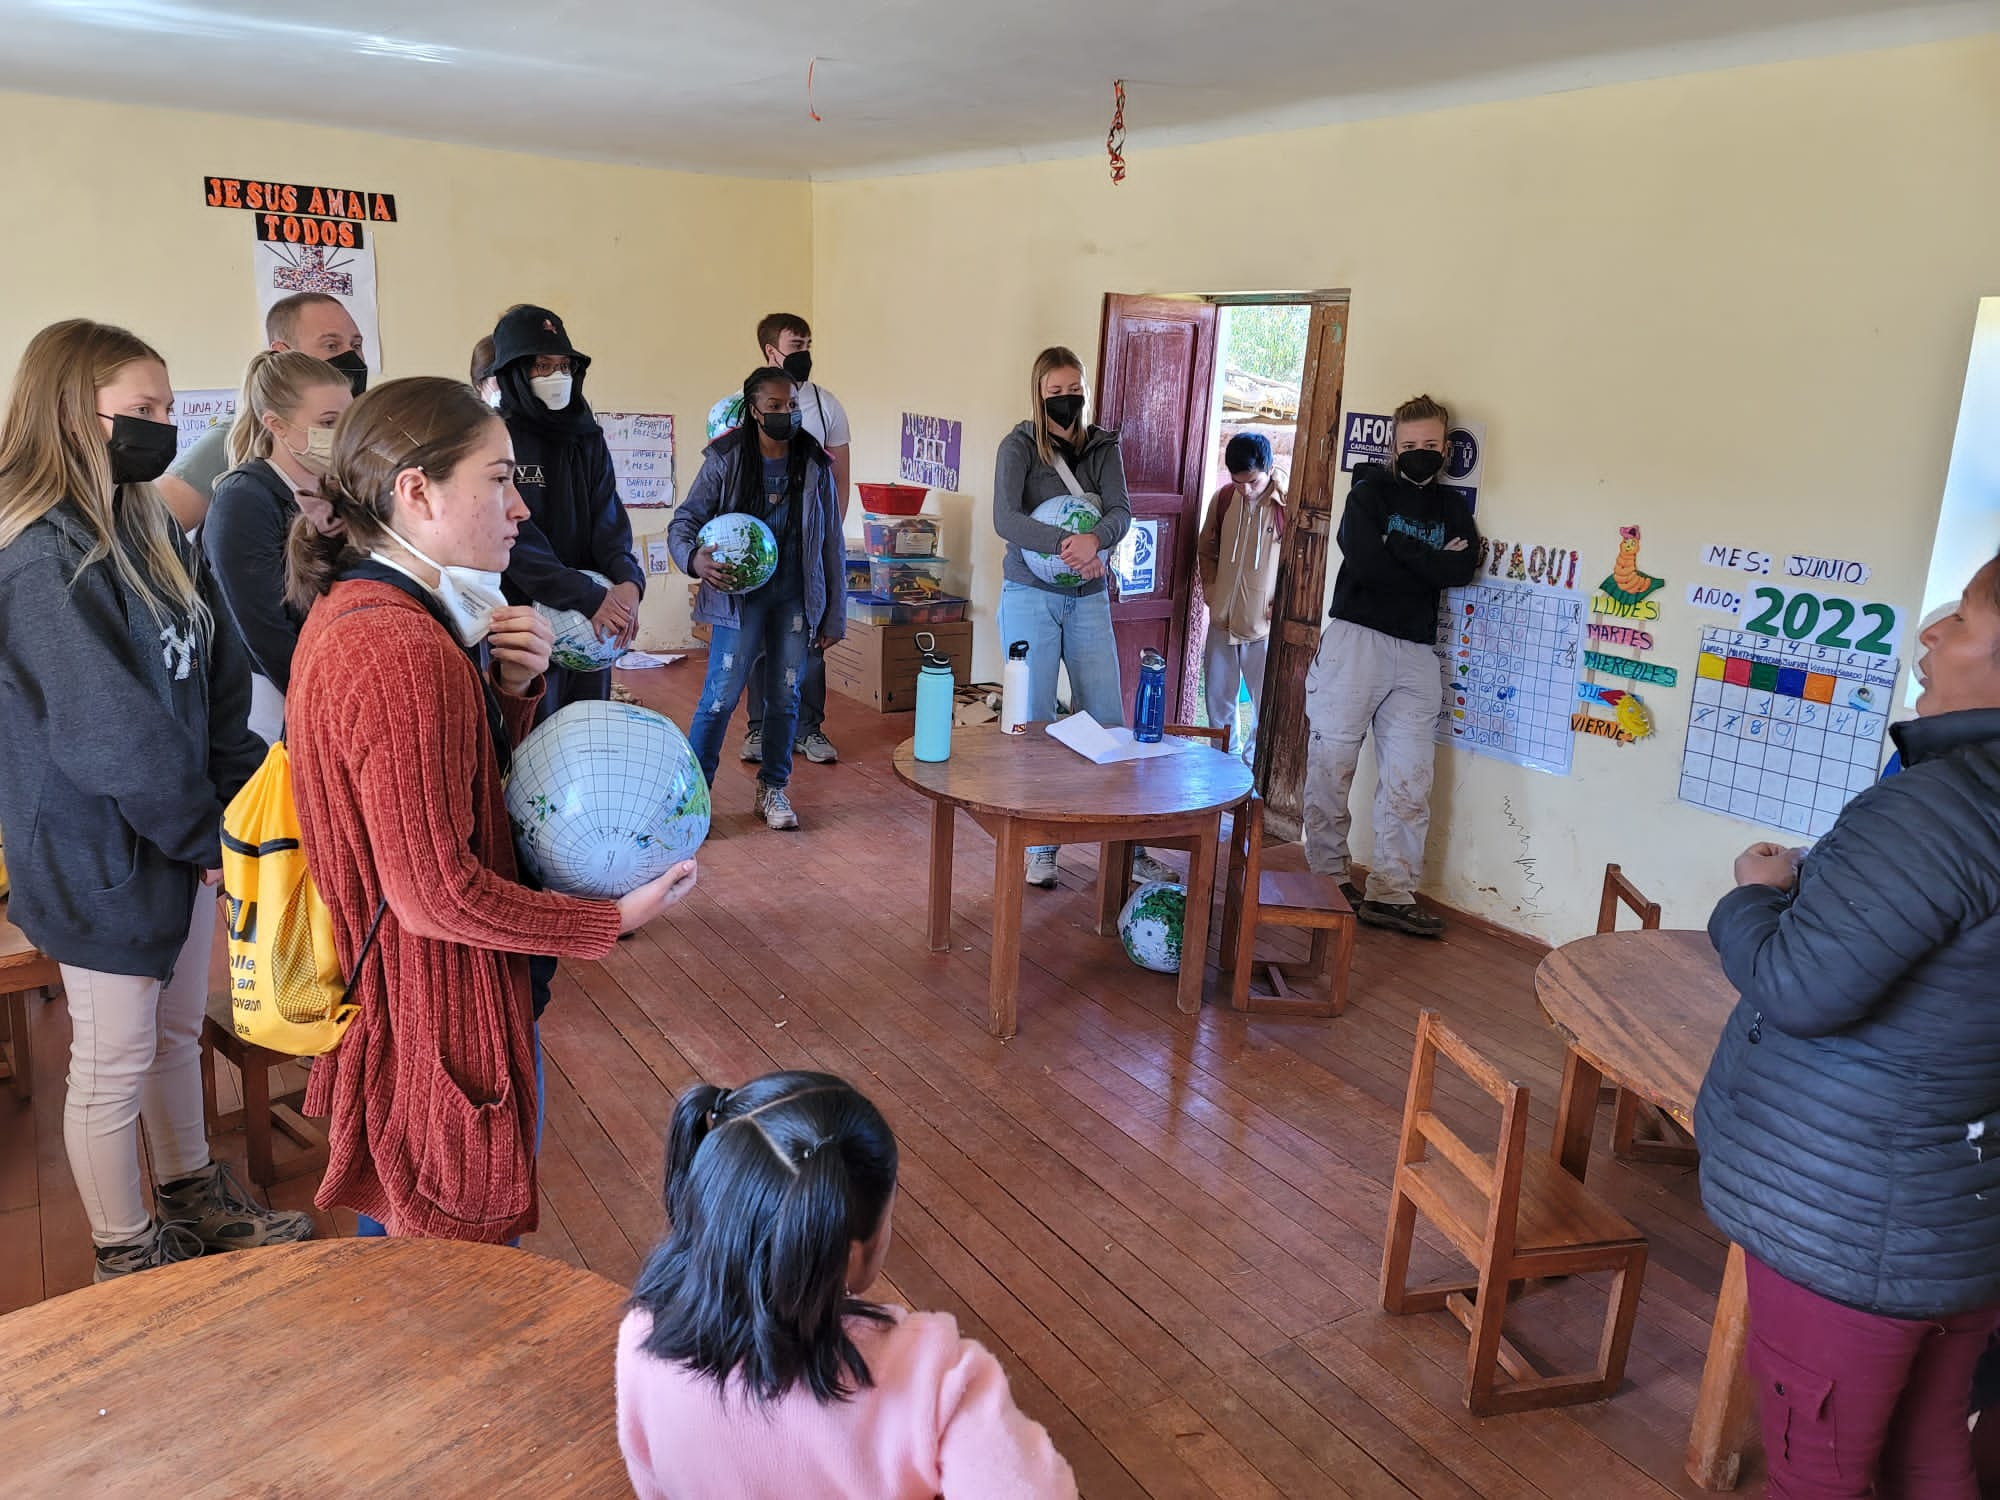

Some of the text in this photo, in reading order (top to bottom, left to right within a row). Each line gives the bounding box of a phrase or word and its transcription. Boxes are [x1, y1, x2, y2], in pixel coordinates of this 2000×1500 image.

[207, 179, 391, 221] JESUS AMA A
[263, 214, 356, 247] TODOS
[1349, 417, 1394, 445] AFOR
[1708, 545, 1864, 584] MES: JUNIO
[1587, 624, 1653, 650] MARTES
[1692, 586, 1897, 656] AÑO: 2022
[1584, 652, 1676, 686] MIERCOLES
[1011, 723, 1027, 733] AS
[1571, 716, 1634, 743] VIERNE
